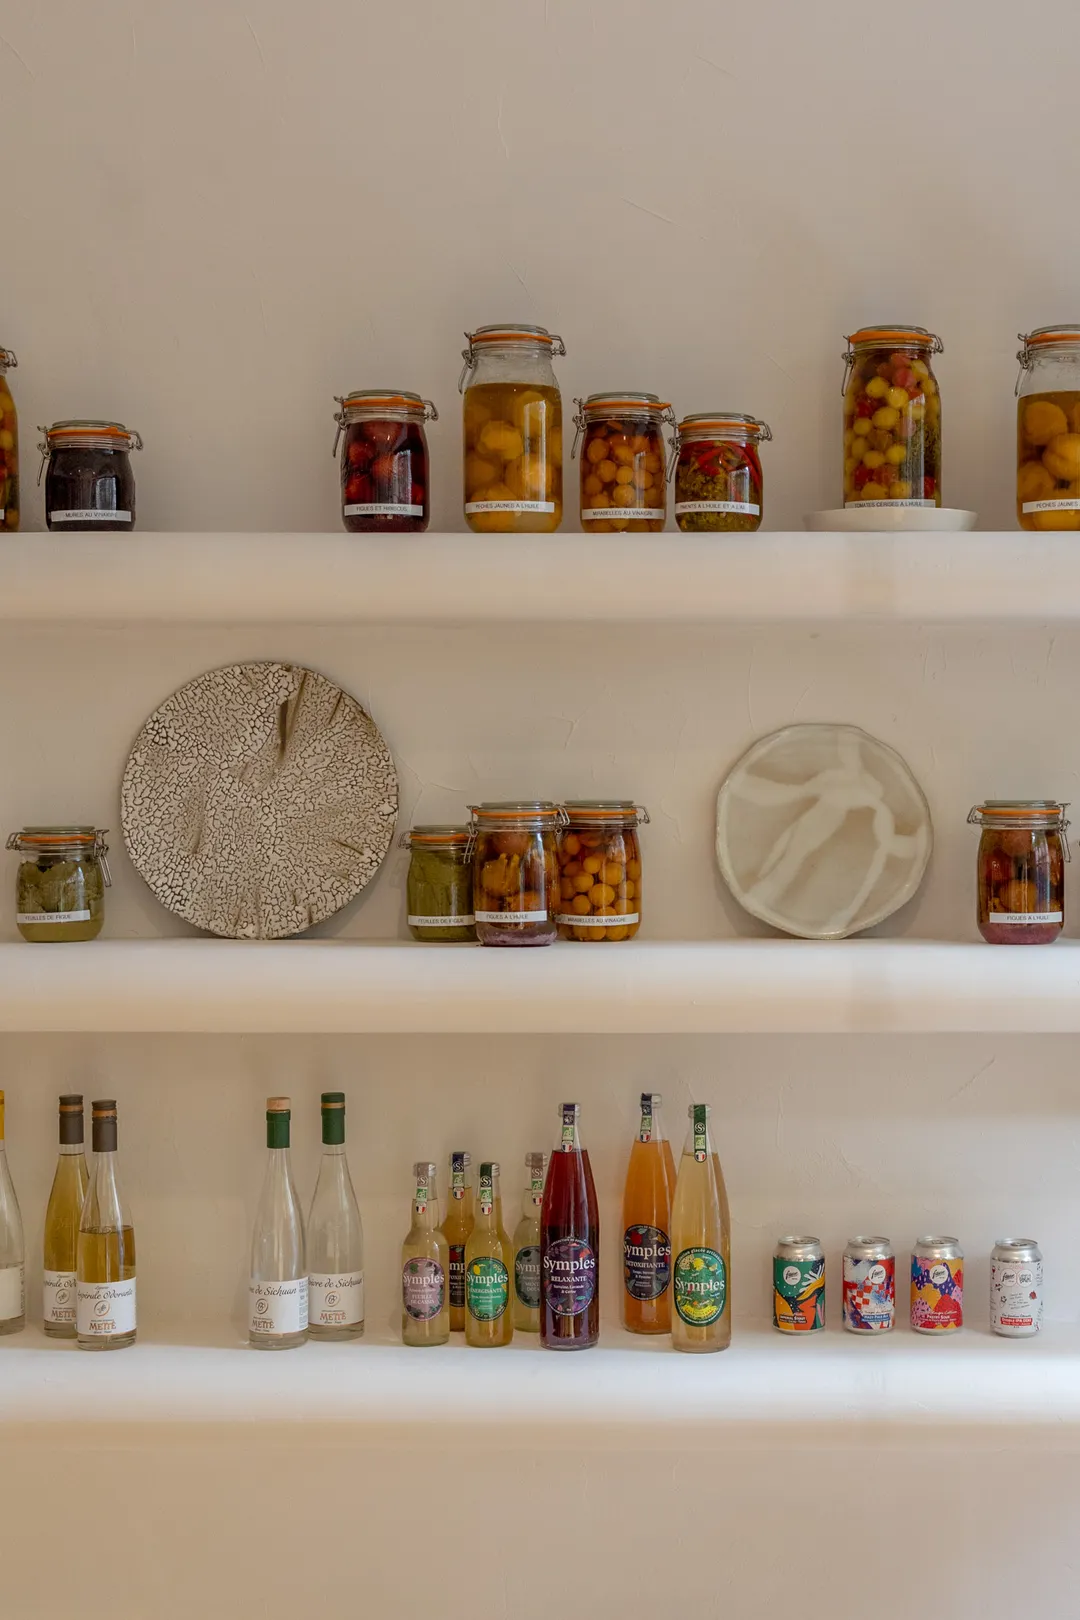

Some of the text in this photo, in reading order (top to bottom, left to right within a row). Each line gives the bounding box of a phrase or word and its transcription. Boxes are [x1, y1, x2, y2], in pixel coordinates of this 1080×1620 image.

[624, 1242, 671, 1260] Symples
[516, 1260, 540, 1274] Symp
[543, 1256, 595, 1273] Symples
[324, 1278, 333, 1288] de
[403, 1273, 444, 1287] Symples
[466, 1271, 508, 1286] Symples
[255, 1285, 262, 1294] de
[264, 1285, 296, 1296] Sichuan
[675, 1277, 725, 1295] Symples
